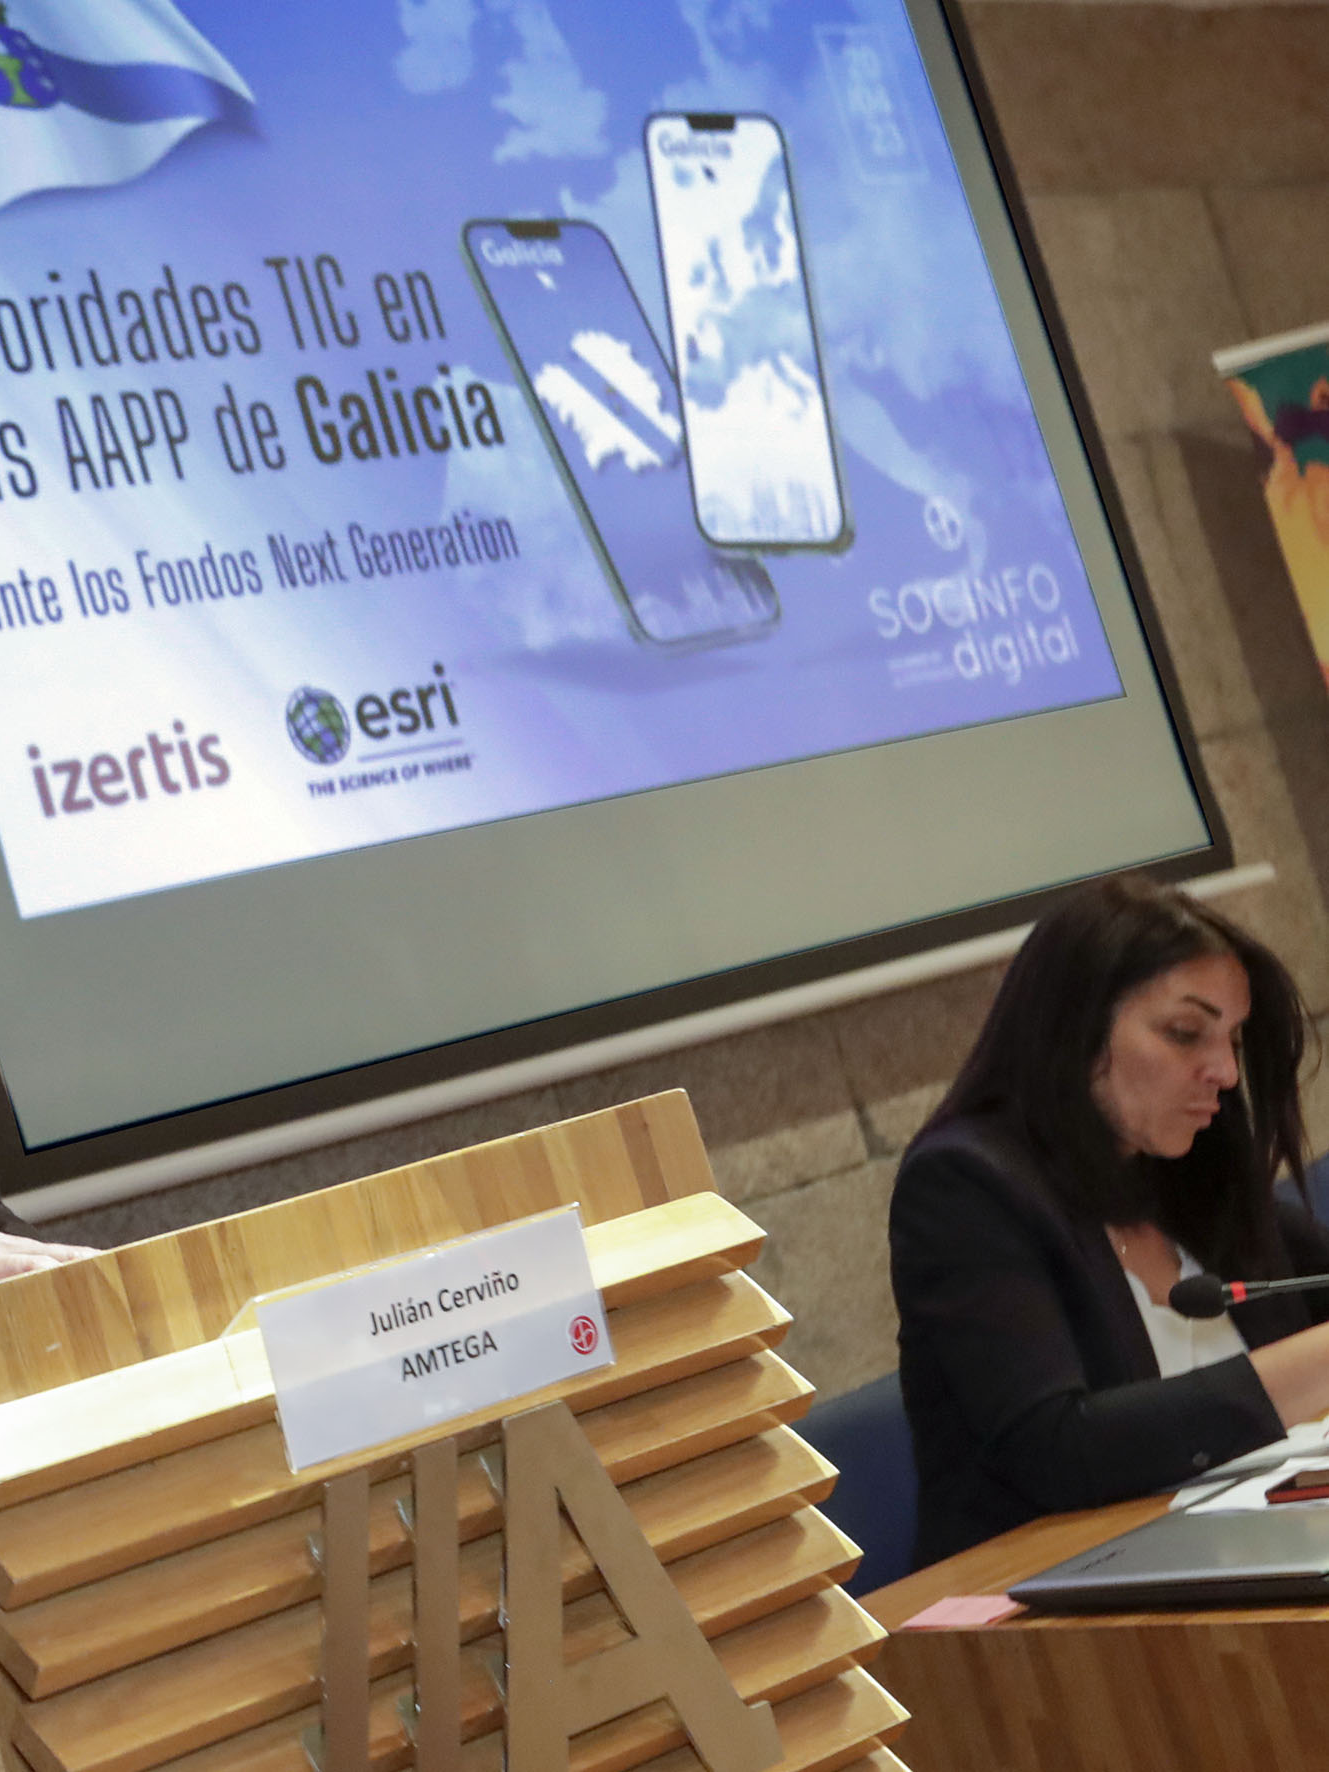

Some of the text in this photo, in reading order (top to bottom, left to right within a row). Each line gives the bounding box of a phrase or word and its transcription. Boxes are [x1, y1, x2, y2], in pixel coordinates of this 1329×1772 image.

[264, 253, 360, 350] TIC
[374, 268, 446, 344] en
[56, 388, 189, 492] AAPP
[214, 383, 287, 475] de
[294, 362, 506, 464] Galicia
[69, 559, 131, 616] los
[136, 541, 263, 609] Fondos
[267, 532, 348, 589] Next
[348, 509, 520, 579] Generation
[868, 562, 1062, 640] SOCINFO
[953, 615, 1080, 686] digital
[355, 661, 459, 740] esri
[27, 719, 231, 819] izertis
[369, 1268, 520, 1336] Julián Cerviño
[400, 1330, 499, 1383] AMTEGA
